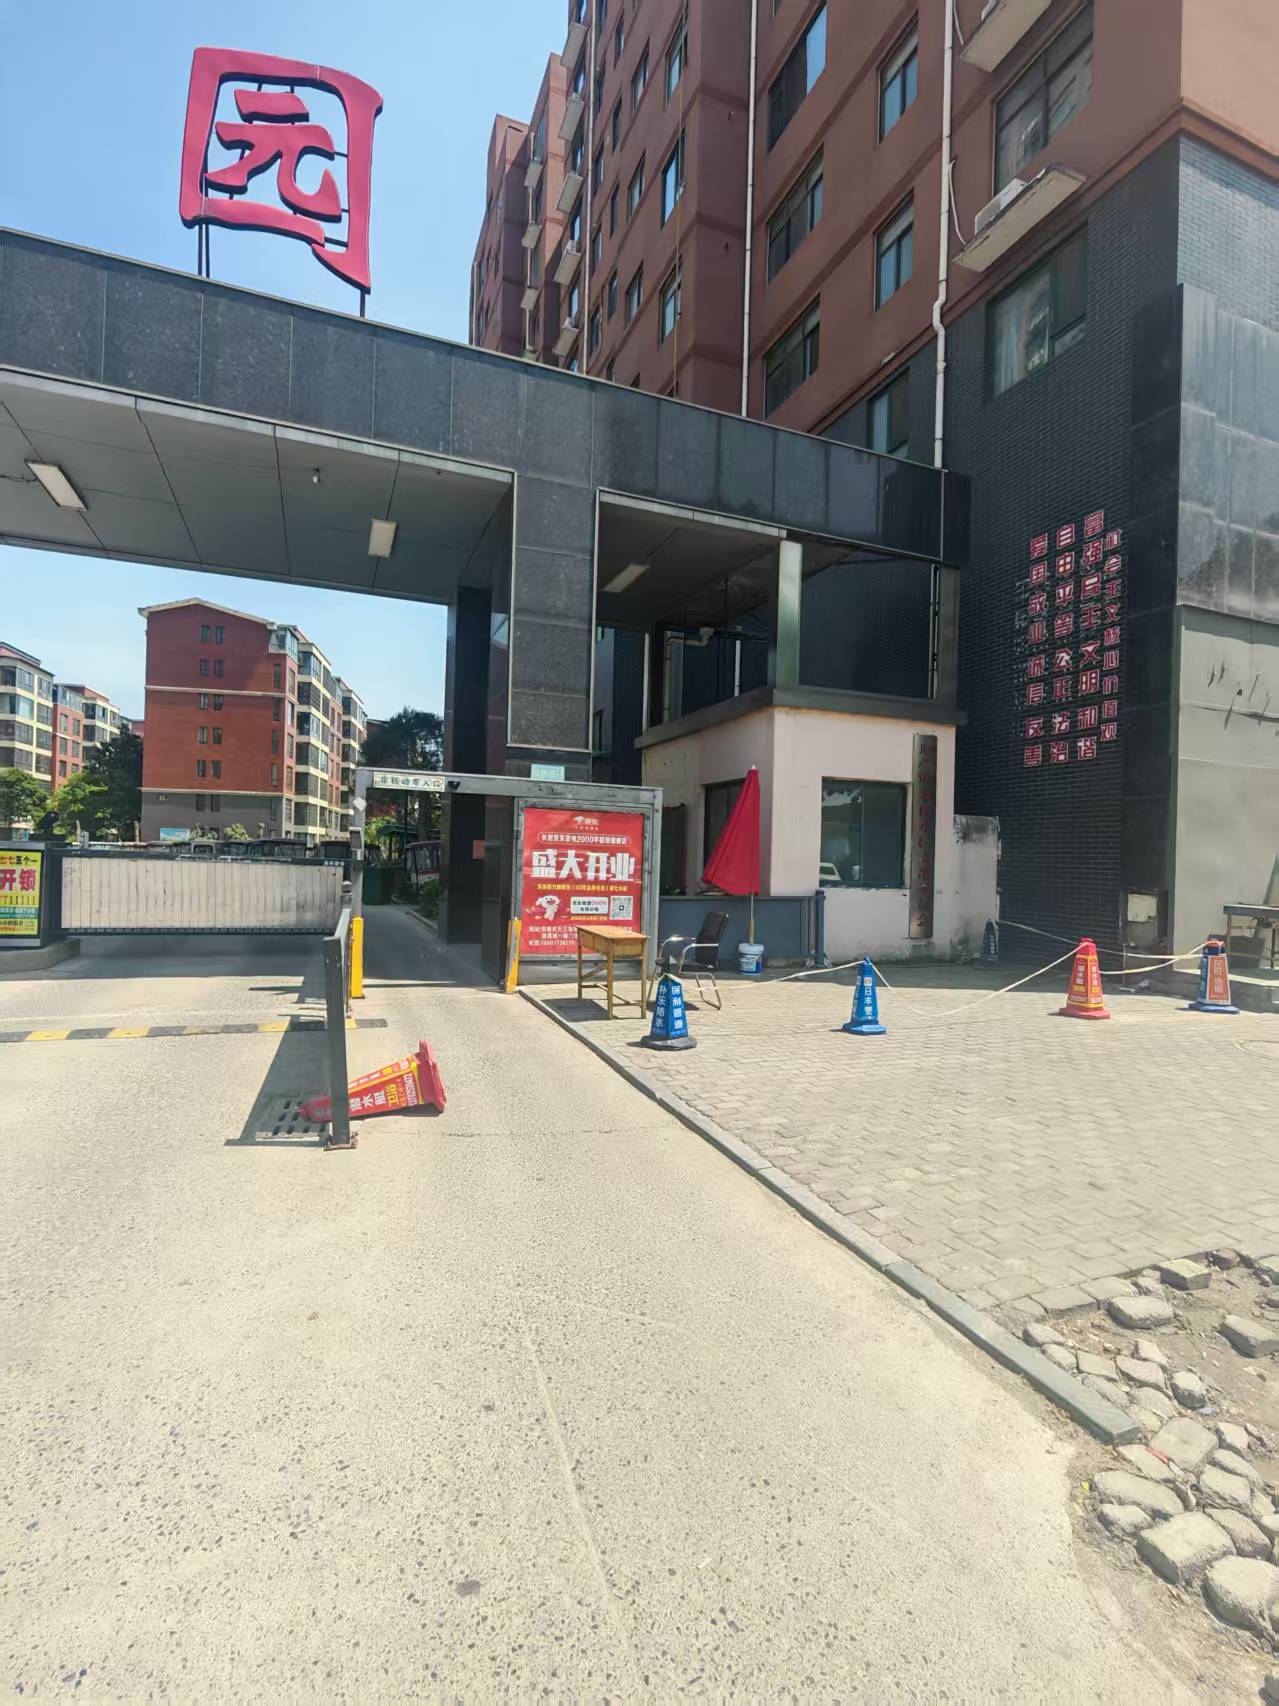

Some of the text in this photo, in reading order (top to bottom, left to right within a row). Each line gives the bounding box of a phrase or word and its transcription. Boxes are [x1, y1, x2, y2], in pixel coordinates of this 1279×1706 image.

[1049, 523, 1075, 763] 自由平等公正法治
[1077, 510, 1104, 760] 富强民主文明和谐
[1100, 529, 1122, 741] 社会主义核心价值观
[380, 775, 441, 788] 非机动车入口
[531, 848, 636, 882] 盛大开业
